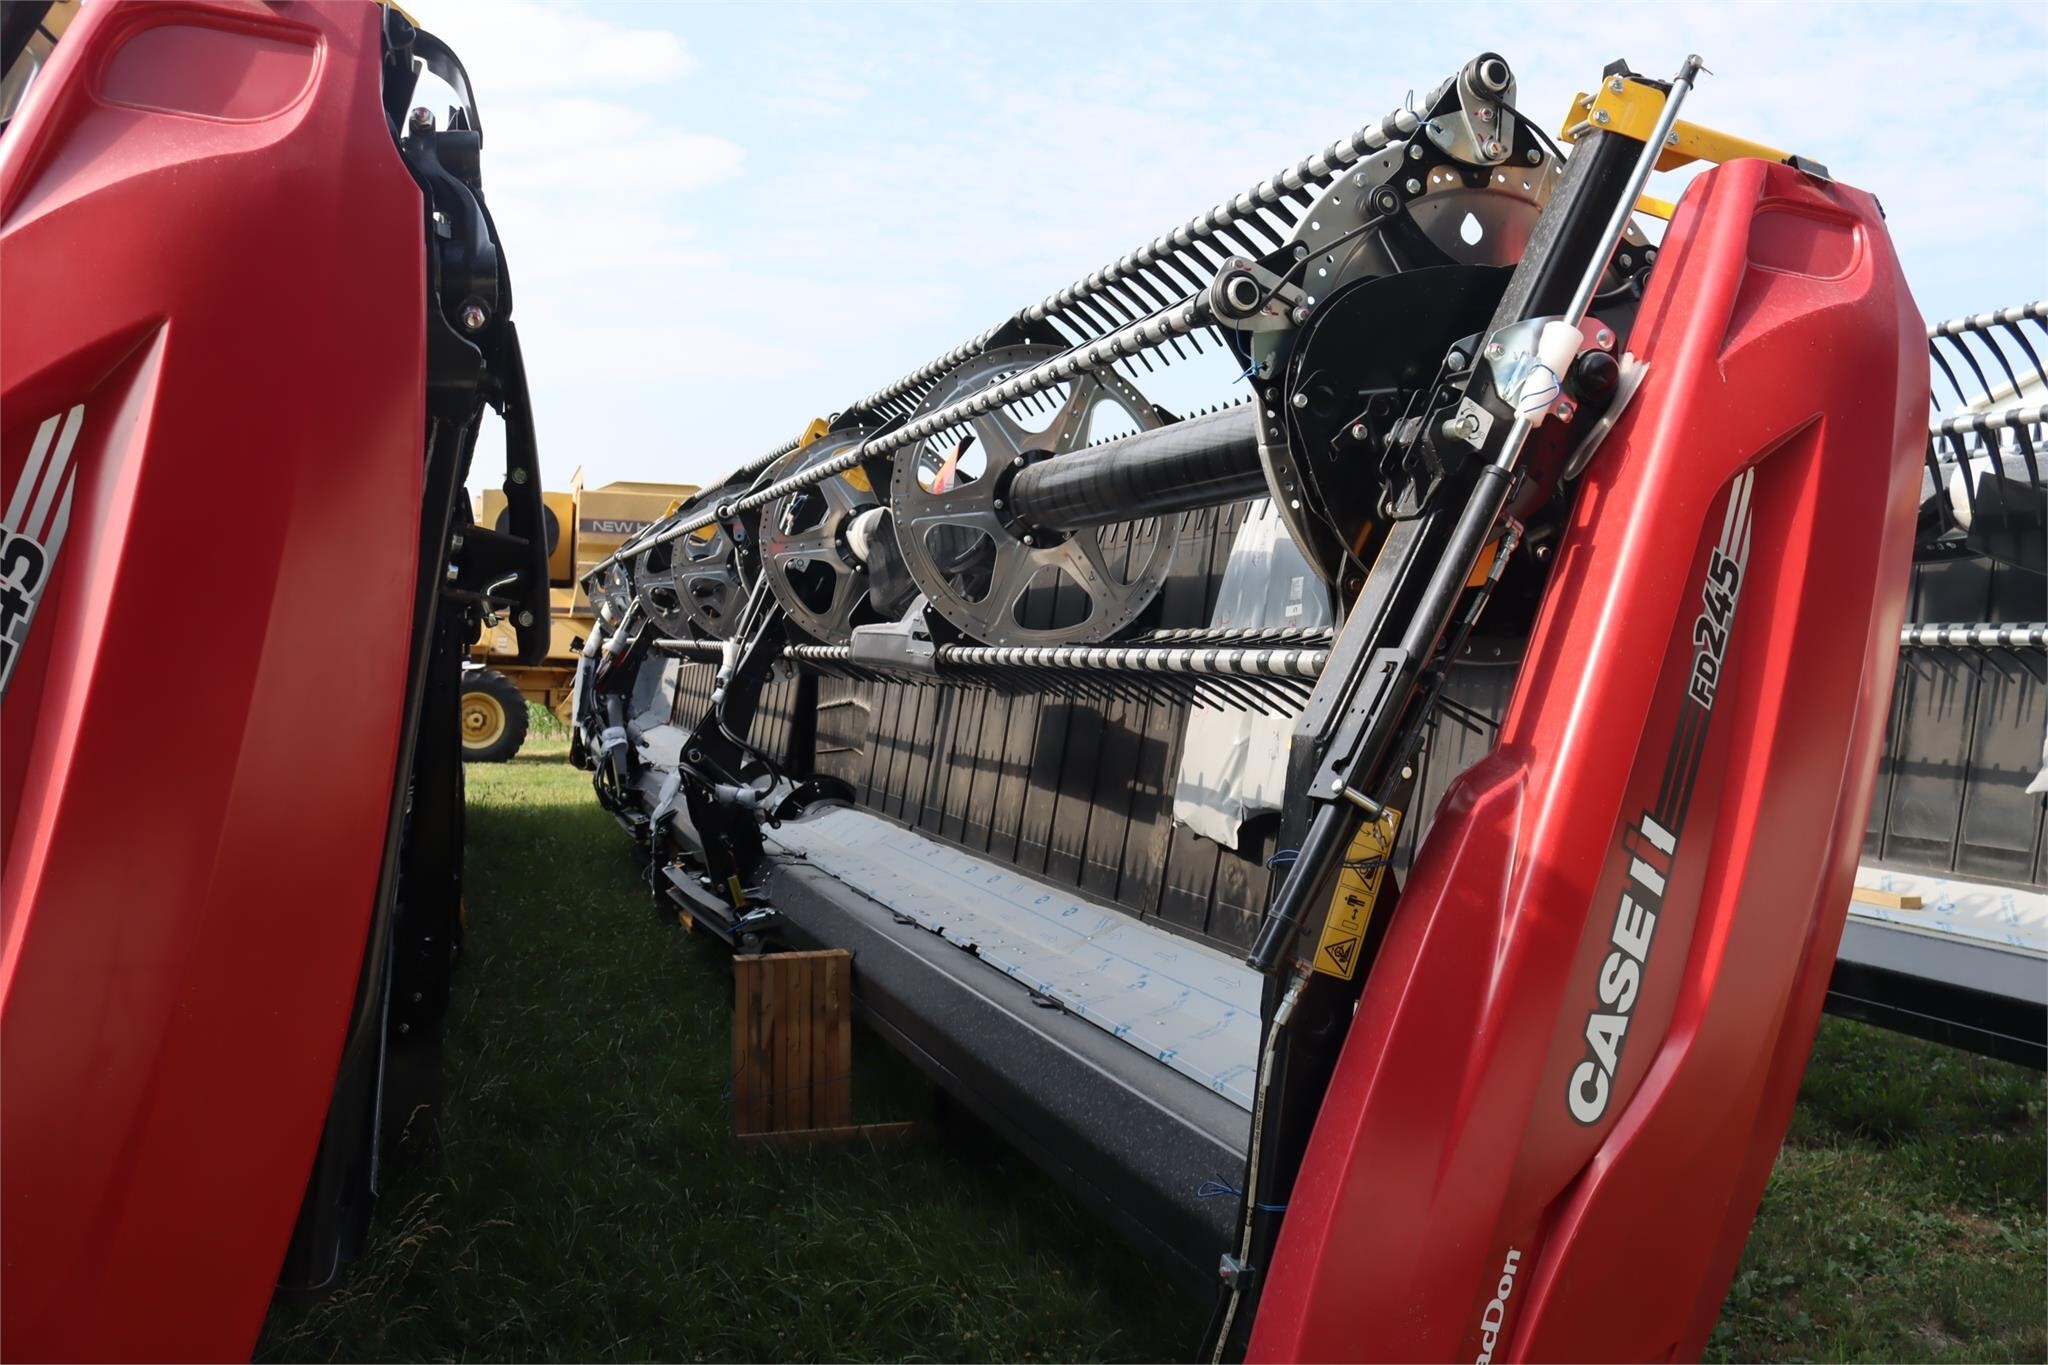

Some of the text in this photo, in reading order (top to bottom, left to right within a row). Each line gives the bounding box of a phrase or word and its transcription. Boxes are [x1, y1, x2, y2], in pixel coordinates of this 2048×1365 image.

[592, 520, 634, 533] NEW
[1689, 546, 1740, 711] FD245
[1568, 893, 1657, 1123] CASE
